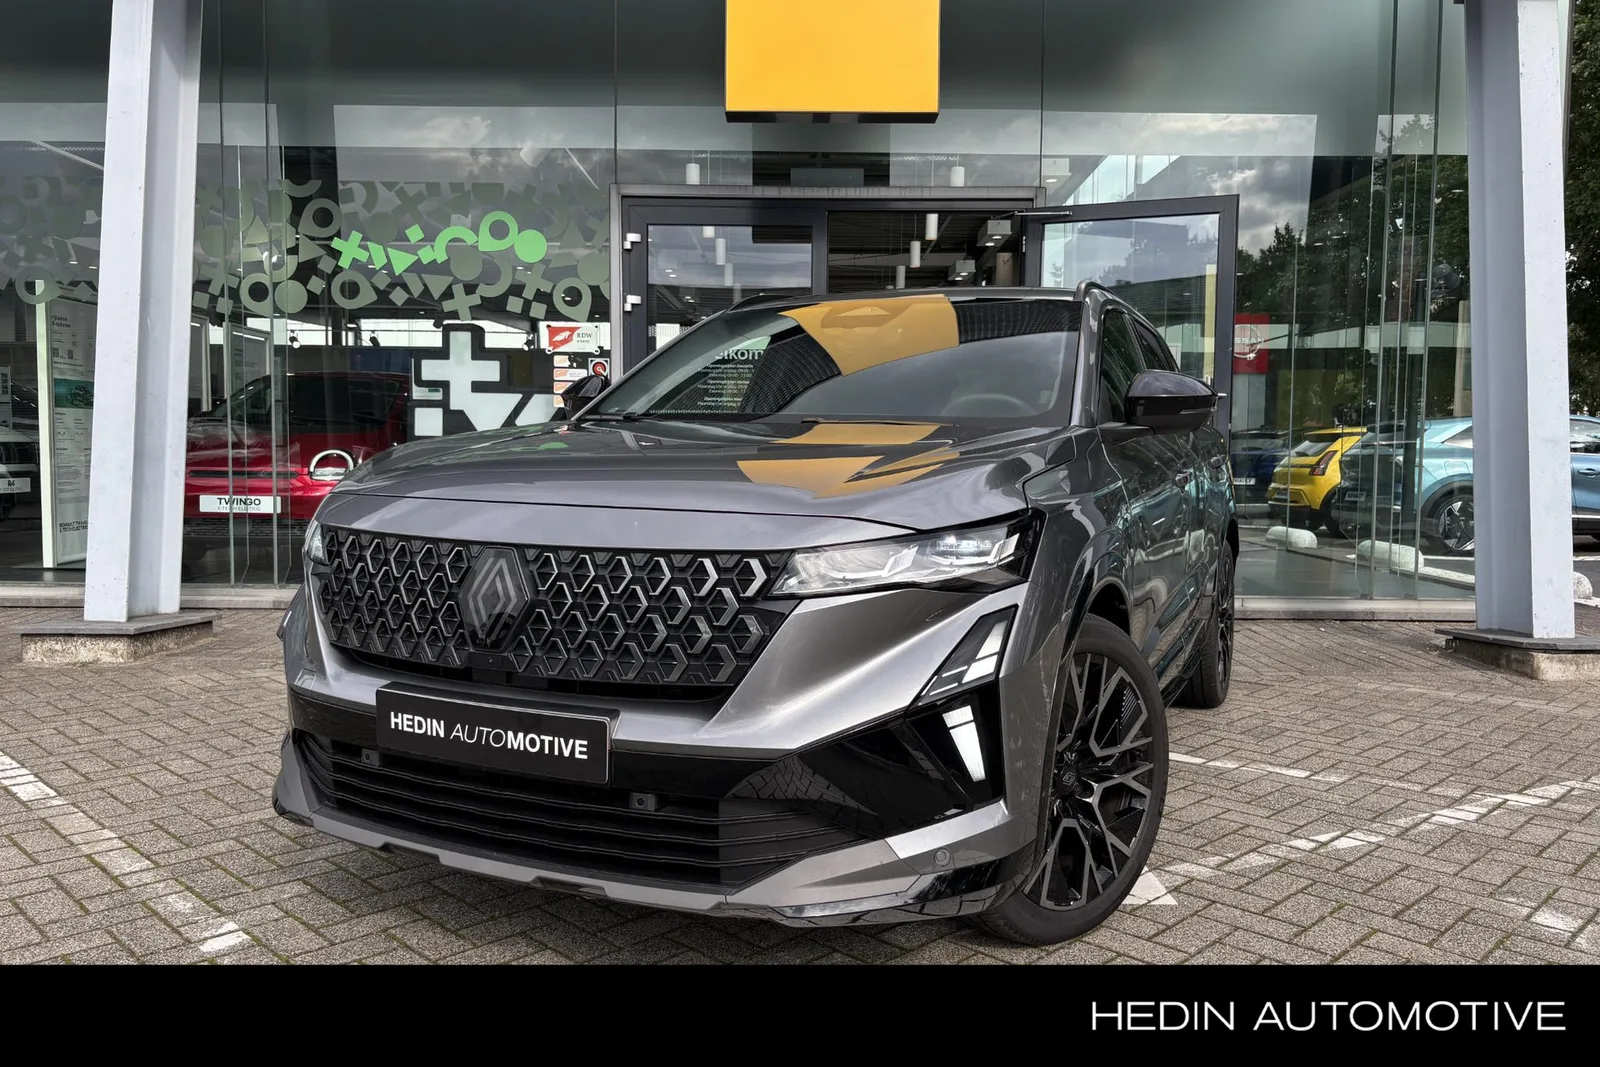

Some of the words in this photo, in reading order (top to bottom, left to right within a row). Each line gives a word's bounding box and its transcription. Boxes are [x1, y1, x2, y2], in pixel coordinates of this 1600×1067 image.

[217, 497, 261, 506] TWINGO
[390, 711, 445, 738] HEDIN
[450, 723, 588, 760] AUTOMOTIVE
